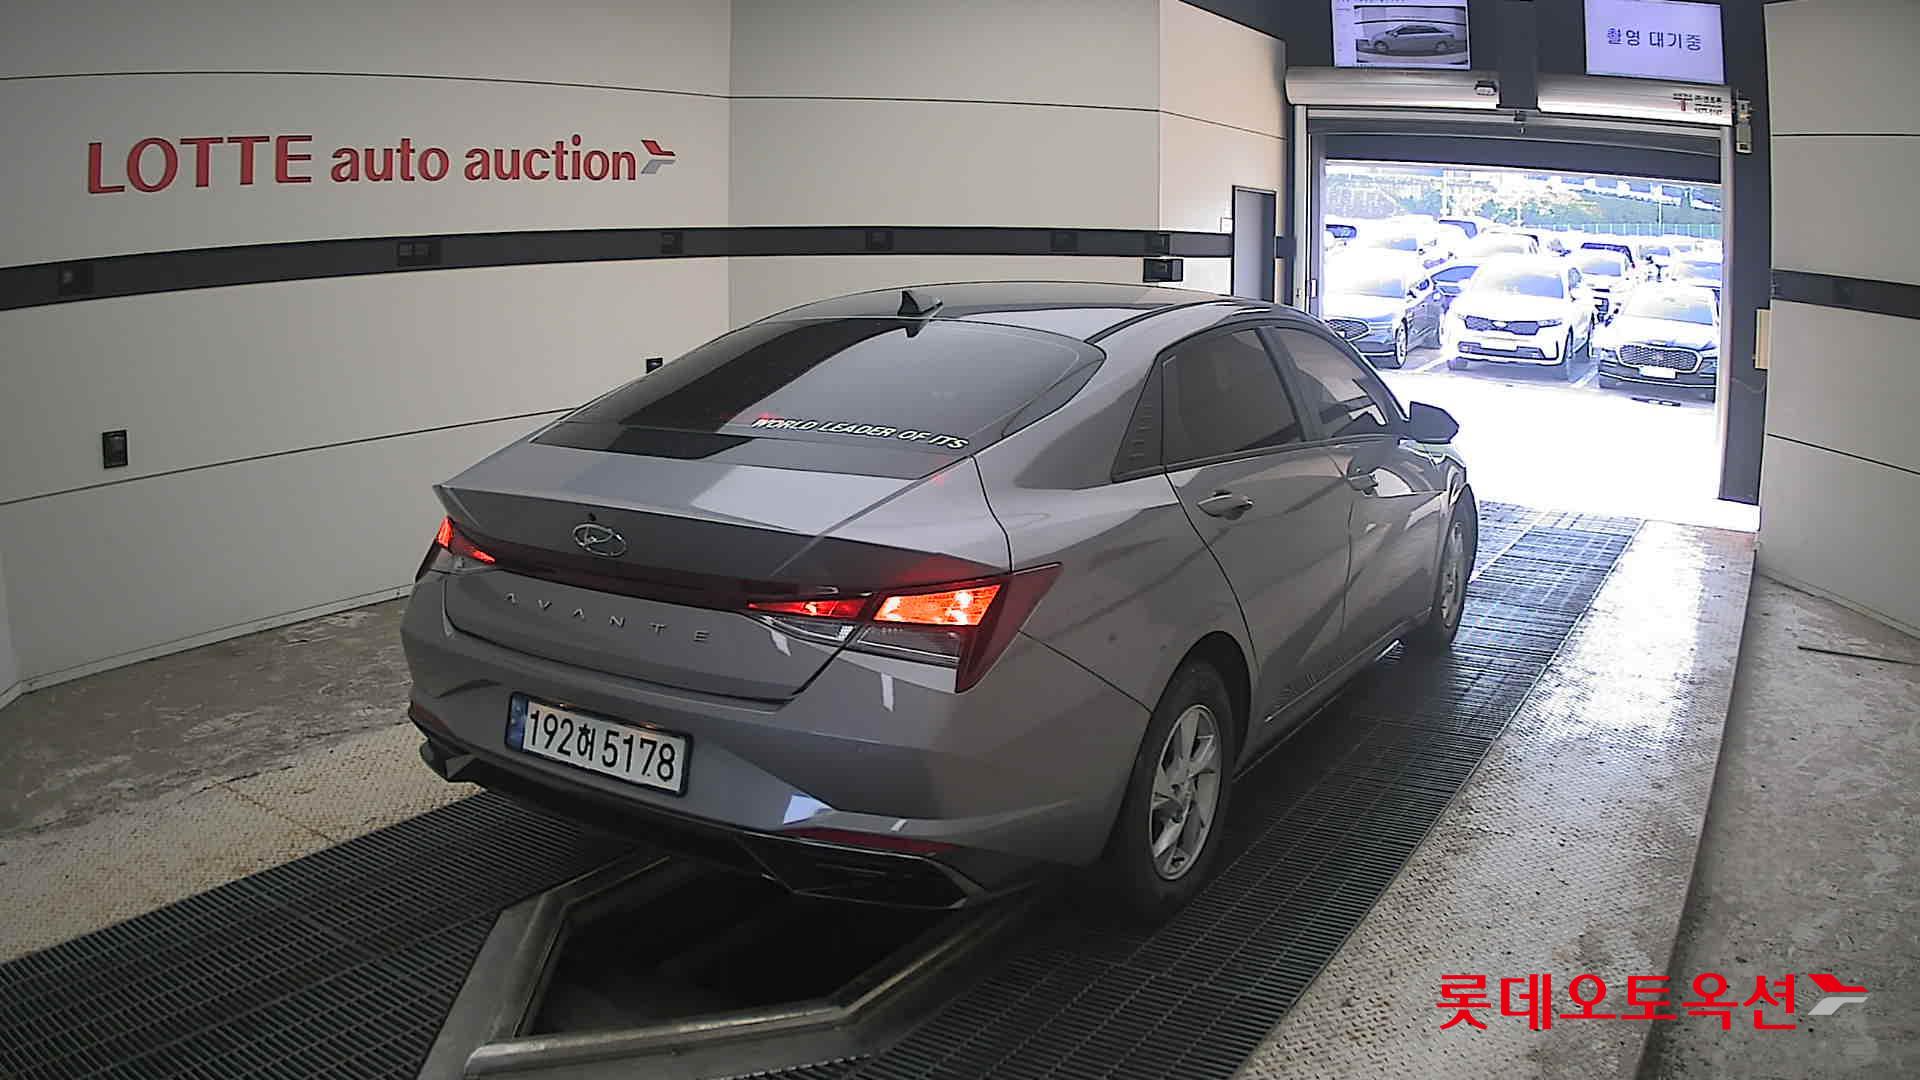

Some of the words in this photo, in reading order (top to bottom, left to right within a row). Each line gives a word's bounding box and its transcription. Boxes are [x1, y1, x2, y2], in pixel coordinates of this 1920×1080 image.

[1649, 31, 1701, 51] 대기중
[87, 134, 313, 194] LOTTE
[330, 138, 450, 183] auto
[463, 133, 638, 182] auction
[752, 417, 818, 431] WORLD
[818, 421, 897, 438] LEADER
[897, 429, 930, 441] OF
[928, 434, 969, 449] ITS
[504, 592, 710, 642] AVANTE
